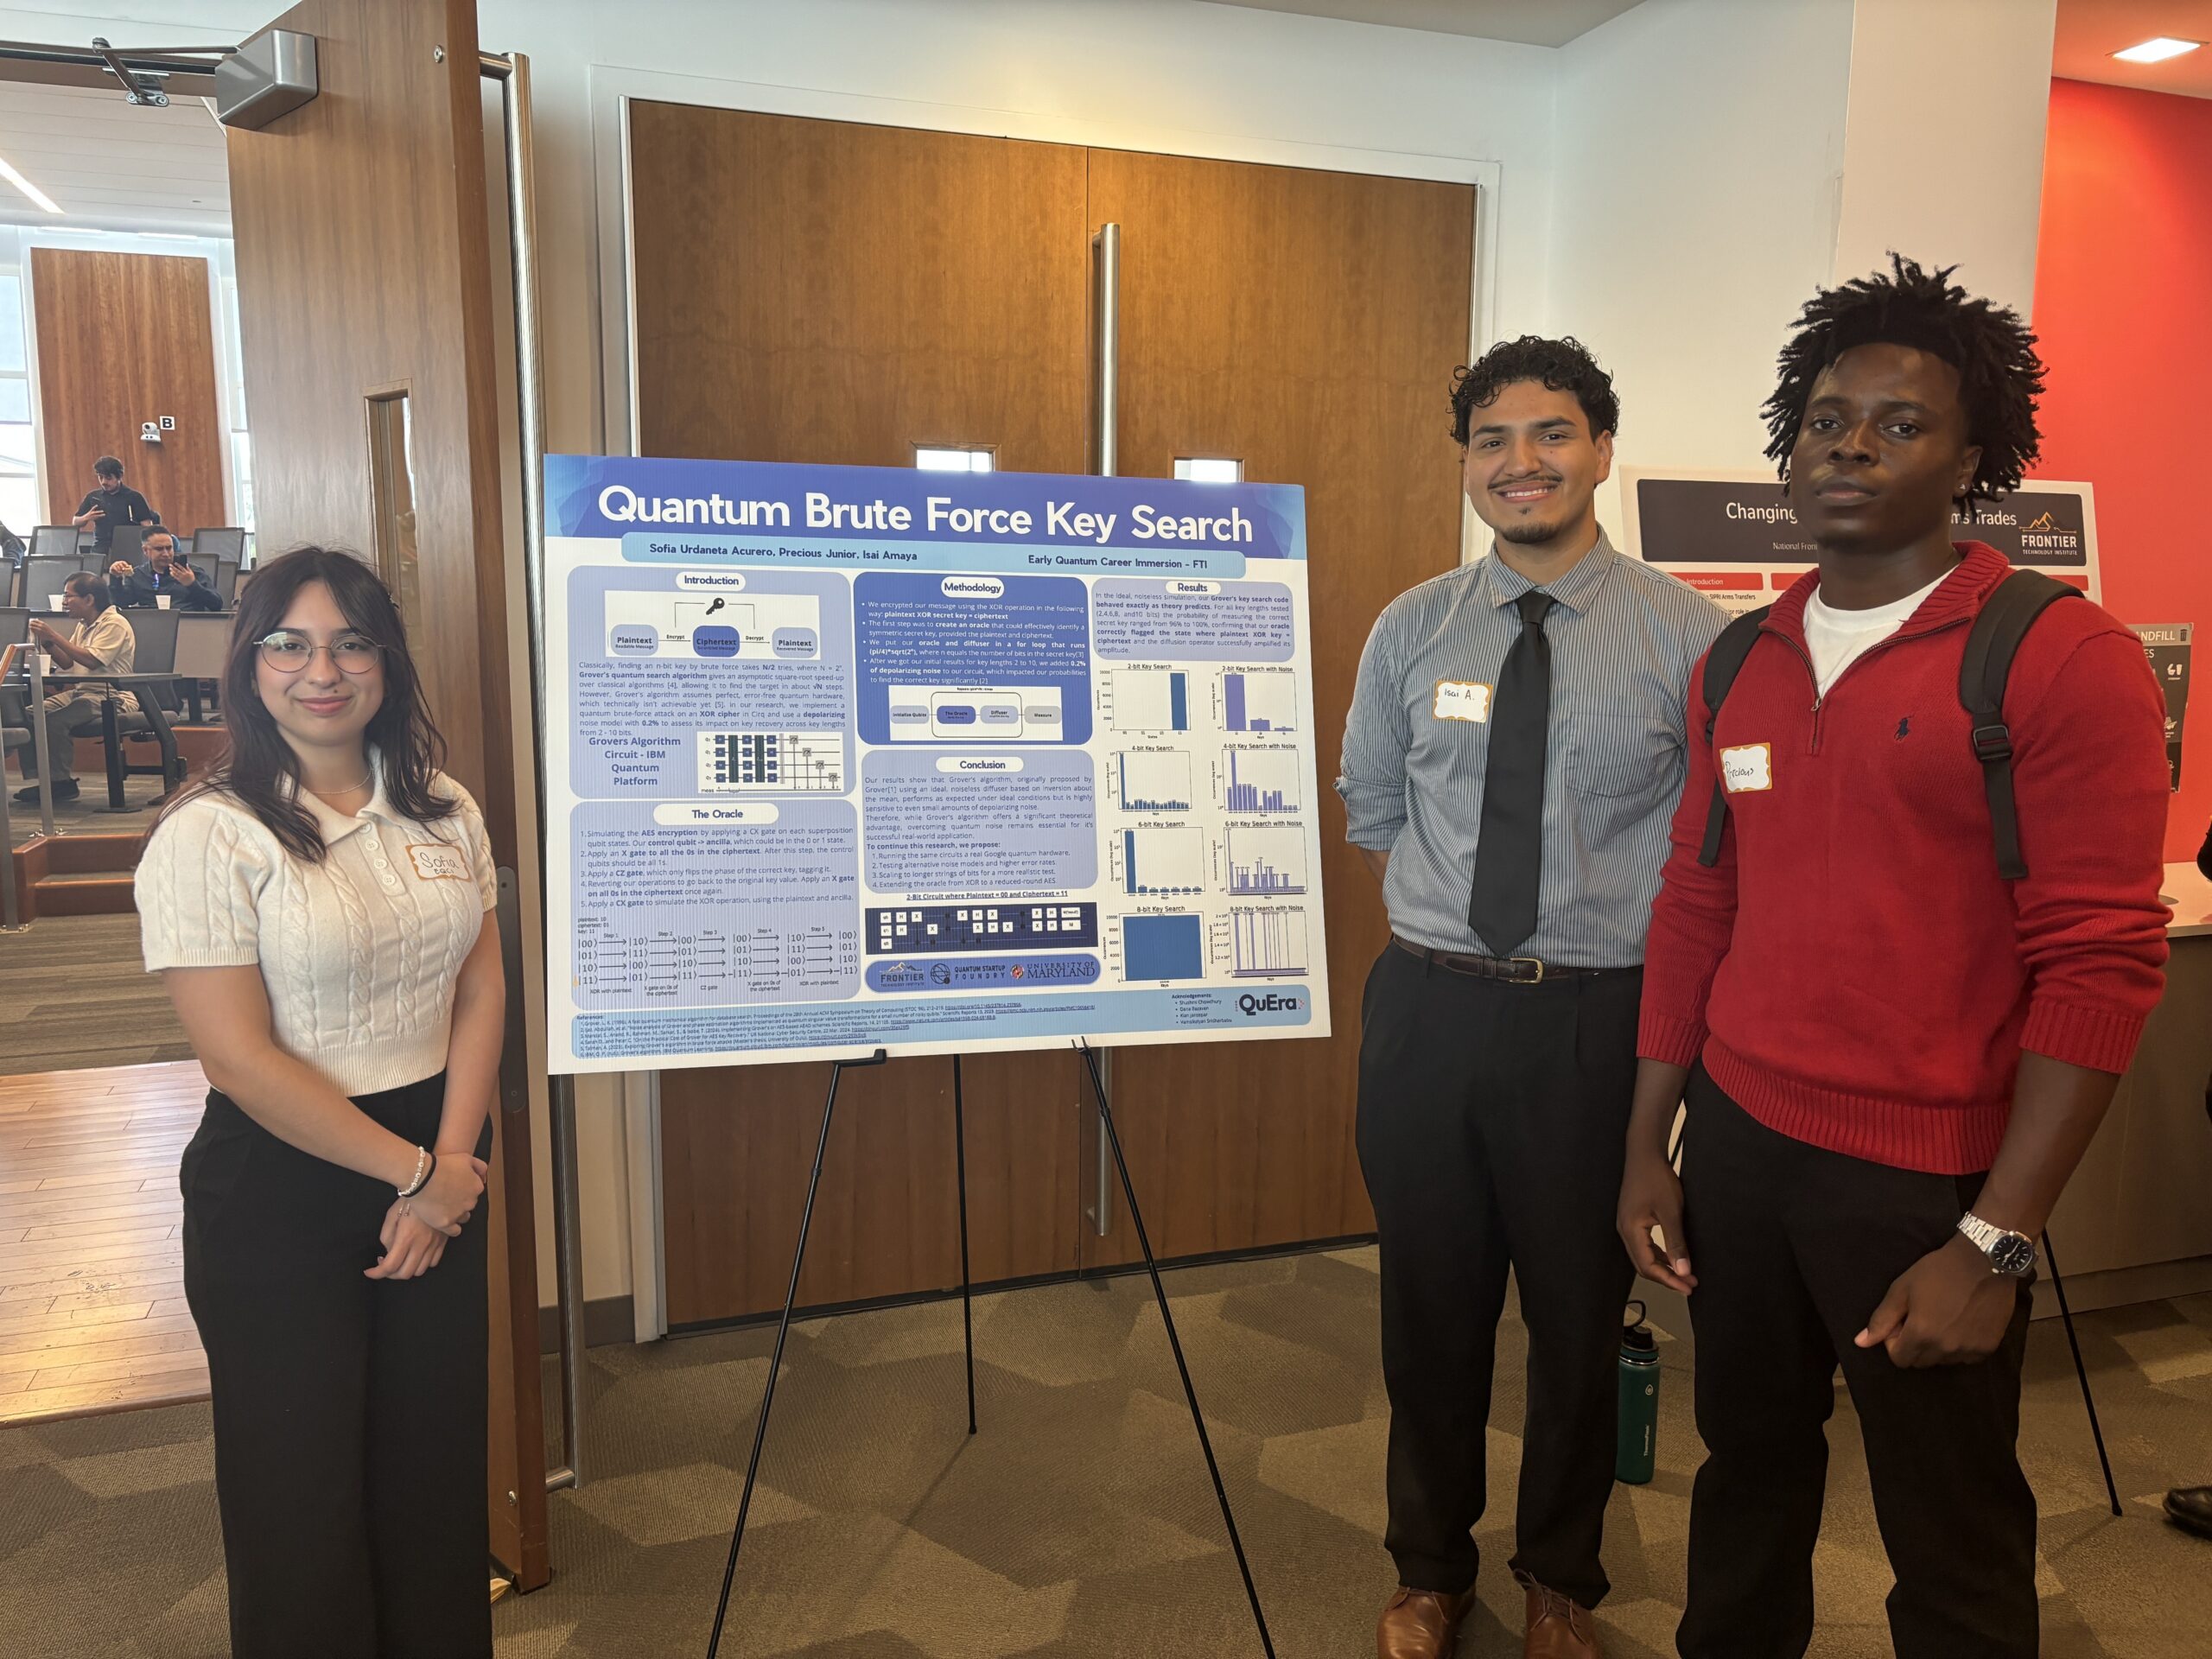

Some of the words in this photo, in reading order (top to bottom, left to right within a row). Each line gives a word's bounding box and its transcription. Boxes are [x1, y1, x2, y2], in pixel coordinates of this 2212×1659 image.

[162, 418, 172, 428] B
[598, 485, 789, 527] Quantum
[806, 492, 911, 531] Brute
[927, 497, 1032, 535] Force
[1047, 501, 1116, 544] Key
[1131, 504, 1252, 542] Search
[1726, 502, 1798, 524] Changing
[1975, 509, 2017, 525] Trades
[2021, 535, 2077, 548] FRONTIER
[650, 543, 677, 554] Sofia
[680, 544, 728, 555] Urdaneta
[731, 546, 775, 557] Acurero,
[779, 547, 822, 557] Precious
[825, 549, 860, 559] Junior,
[863, 550, 879, 559] Isai
[882, 550, 917, 561] Amaya
[1028, 555, 1052, 566] Early
[1055, 556, 1097, 567] Quantum
[1100, 557, 1132, 567] Career
[1135, 558, 1182, 568] Immersion
[1193, 560, 1207, 569] FTI
[684, 575, 739, 585] Introduction
[944, 582, 1001, 594] Methodology
[1177, 583, 1208, 592] Results
[884, 611, 915, 619] plaintext
[955, 612, 967, 620] key
[974, 612, 1008, 621] ciphertext
[2136, 630, 2175, 641] NDFILL
[696, 638, 736, 646] Ciphertext
[1445, 688, 1459, 697] Isai
[1465, 689, 1475, 700] A.
[589, 737, 628, 746] Grovers
[630, 737, 681, 747] Algorithm
[604, 750, 638, 759] Circuit
[647, 750, 665, 759] IBM
[611, 764, 659, 774] Quantum
[959, 760, 1006, 769] Conclusion
[613, 777, 658, 785] Platform
[691, 809, 709, 818] The
[712, 809, 743, 818] Oracle
[420, 852, 460, 869] Sofia
[881, 973, 924, 982] FRONTIER
[1028, 967, 1095, 978] MARYLAND
[1239, 994, 1297, 1016] QuEra
